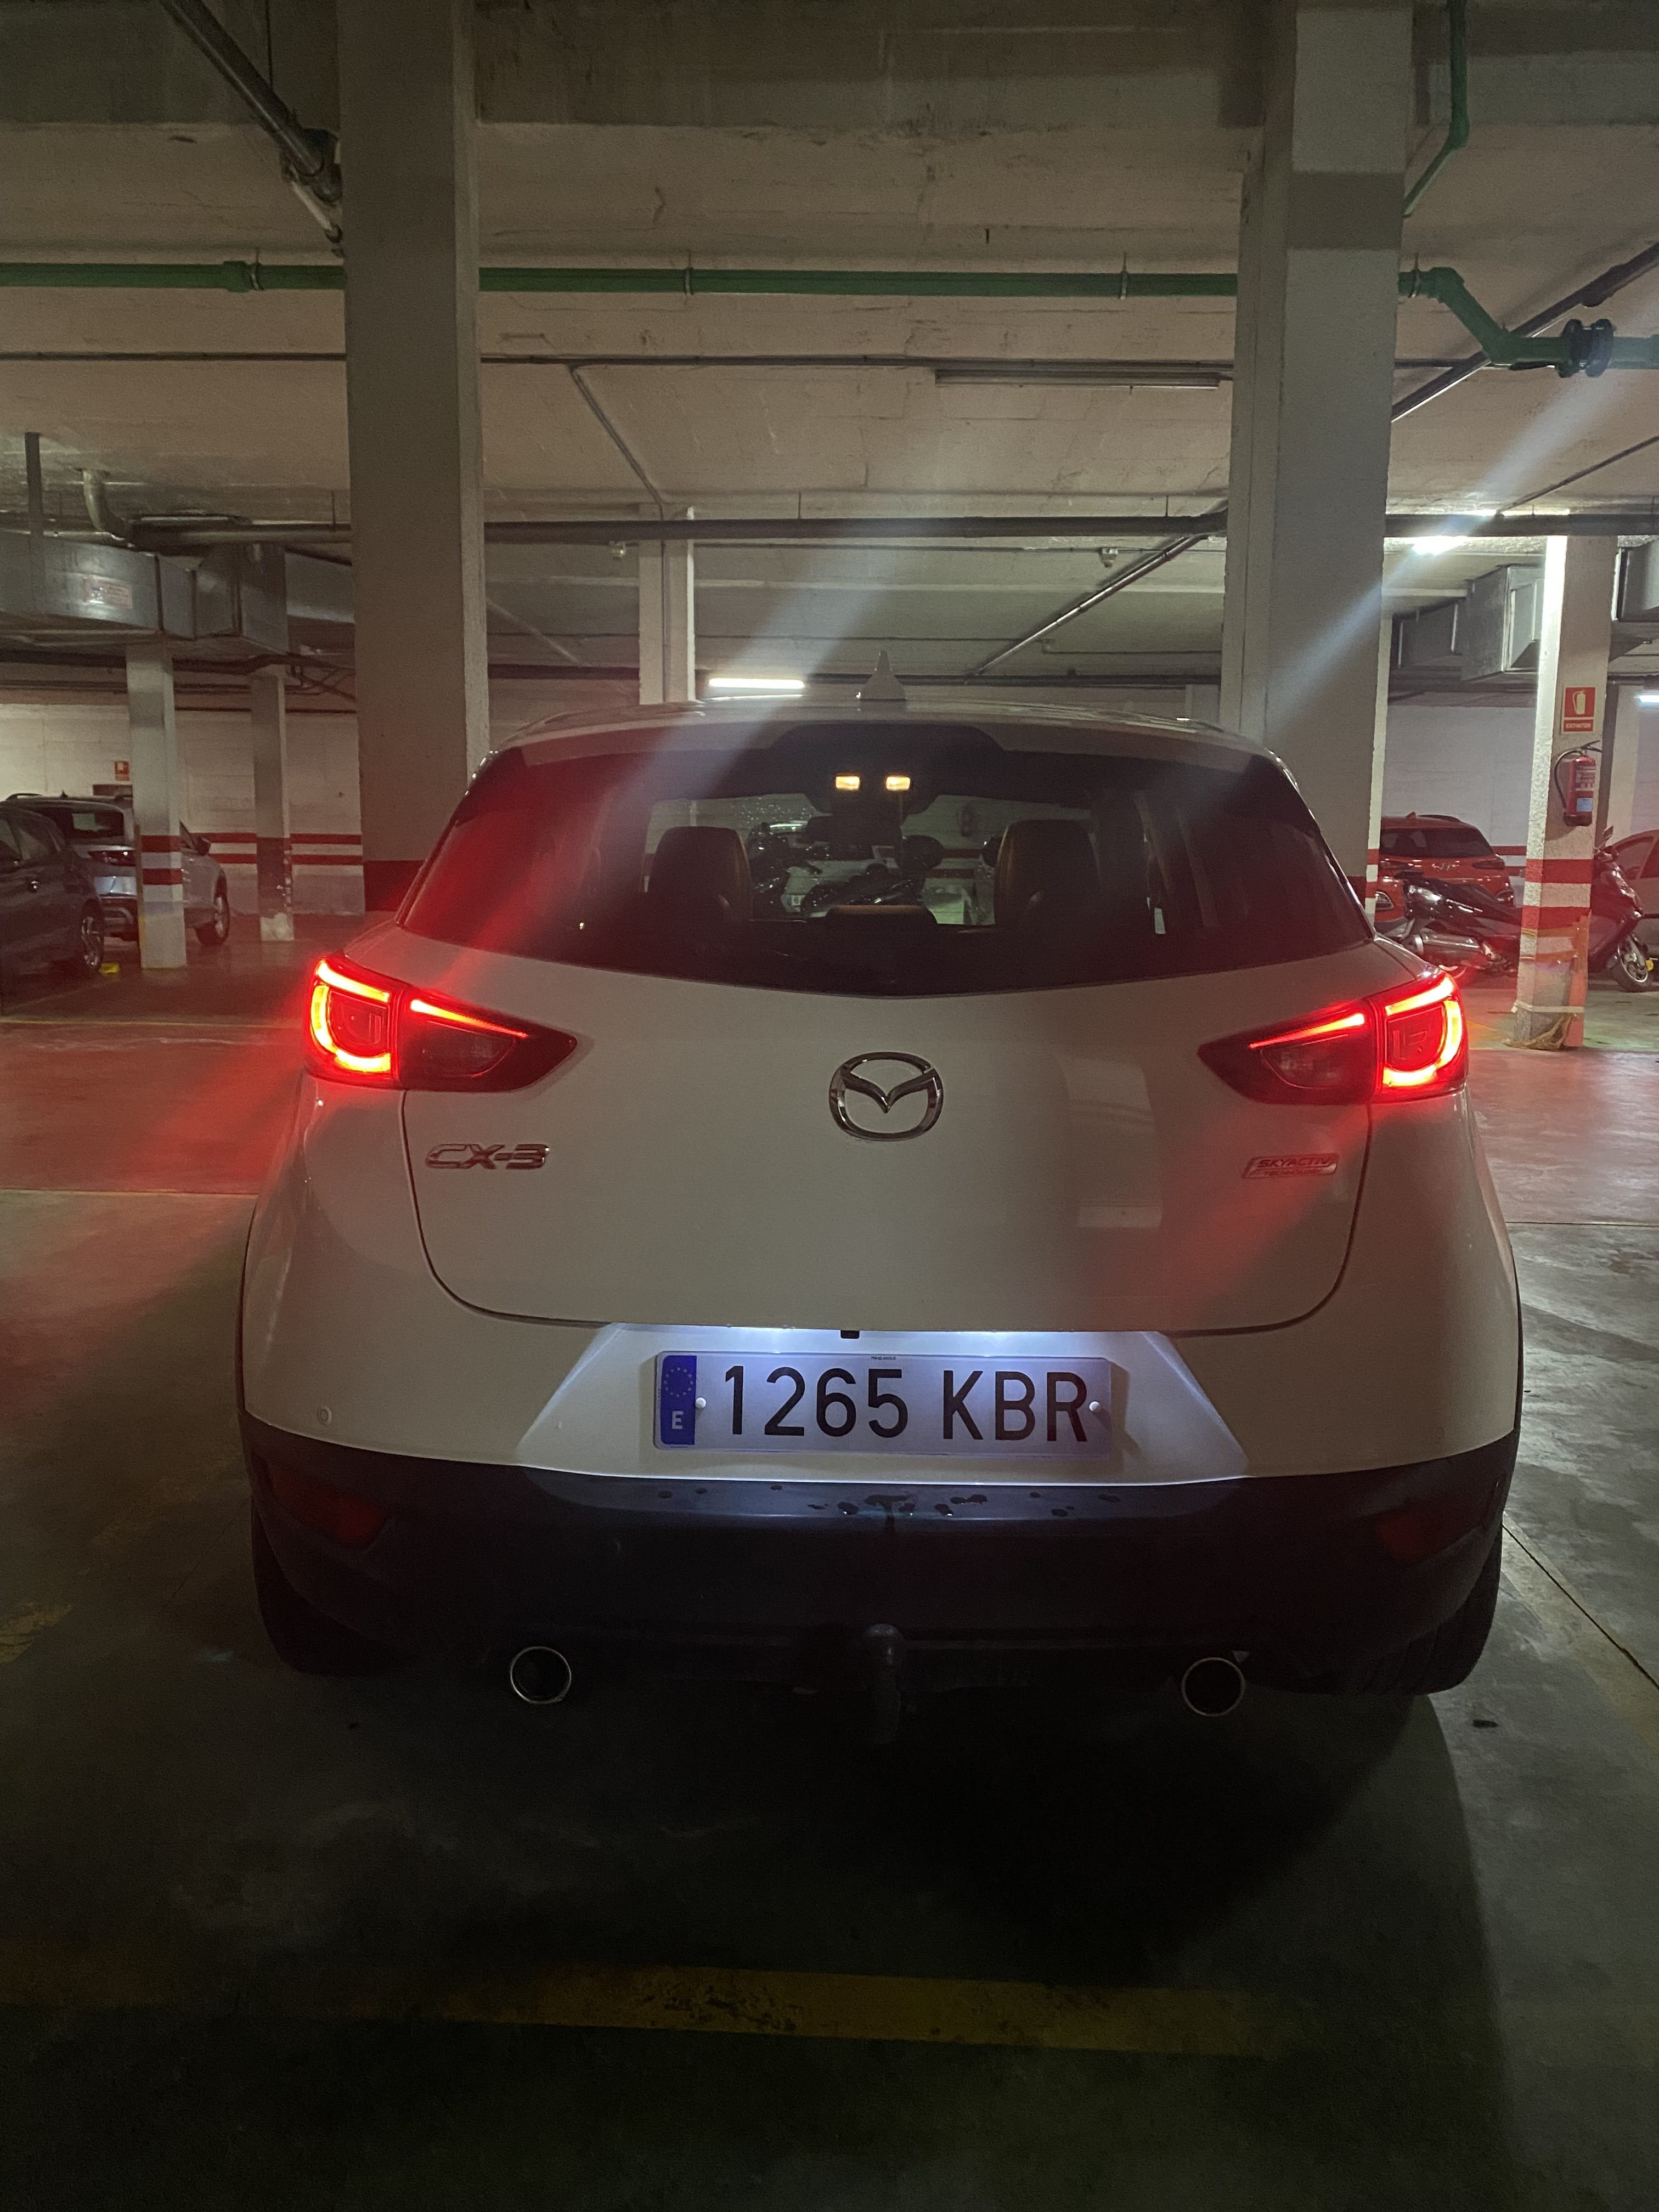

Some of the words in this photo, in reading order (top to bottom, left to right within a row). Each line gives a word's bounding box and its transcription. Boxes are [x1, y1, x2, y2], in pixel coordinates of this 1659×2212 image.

[425, 1143, 549, 1170] CX-3
[1257, 1157, 1331, 1167] SKYACTIV
[725, 1365, 908, 1437] 1265
[943, 1370, 1088, 1442] KBR
[672, 1410, 684, 1429] E
